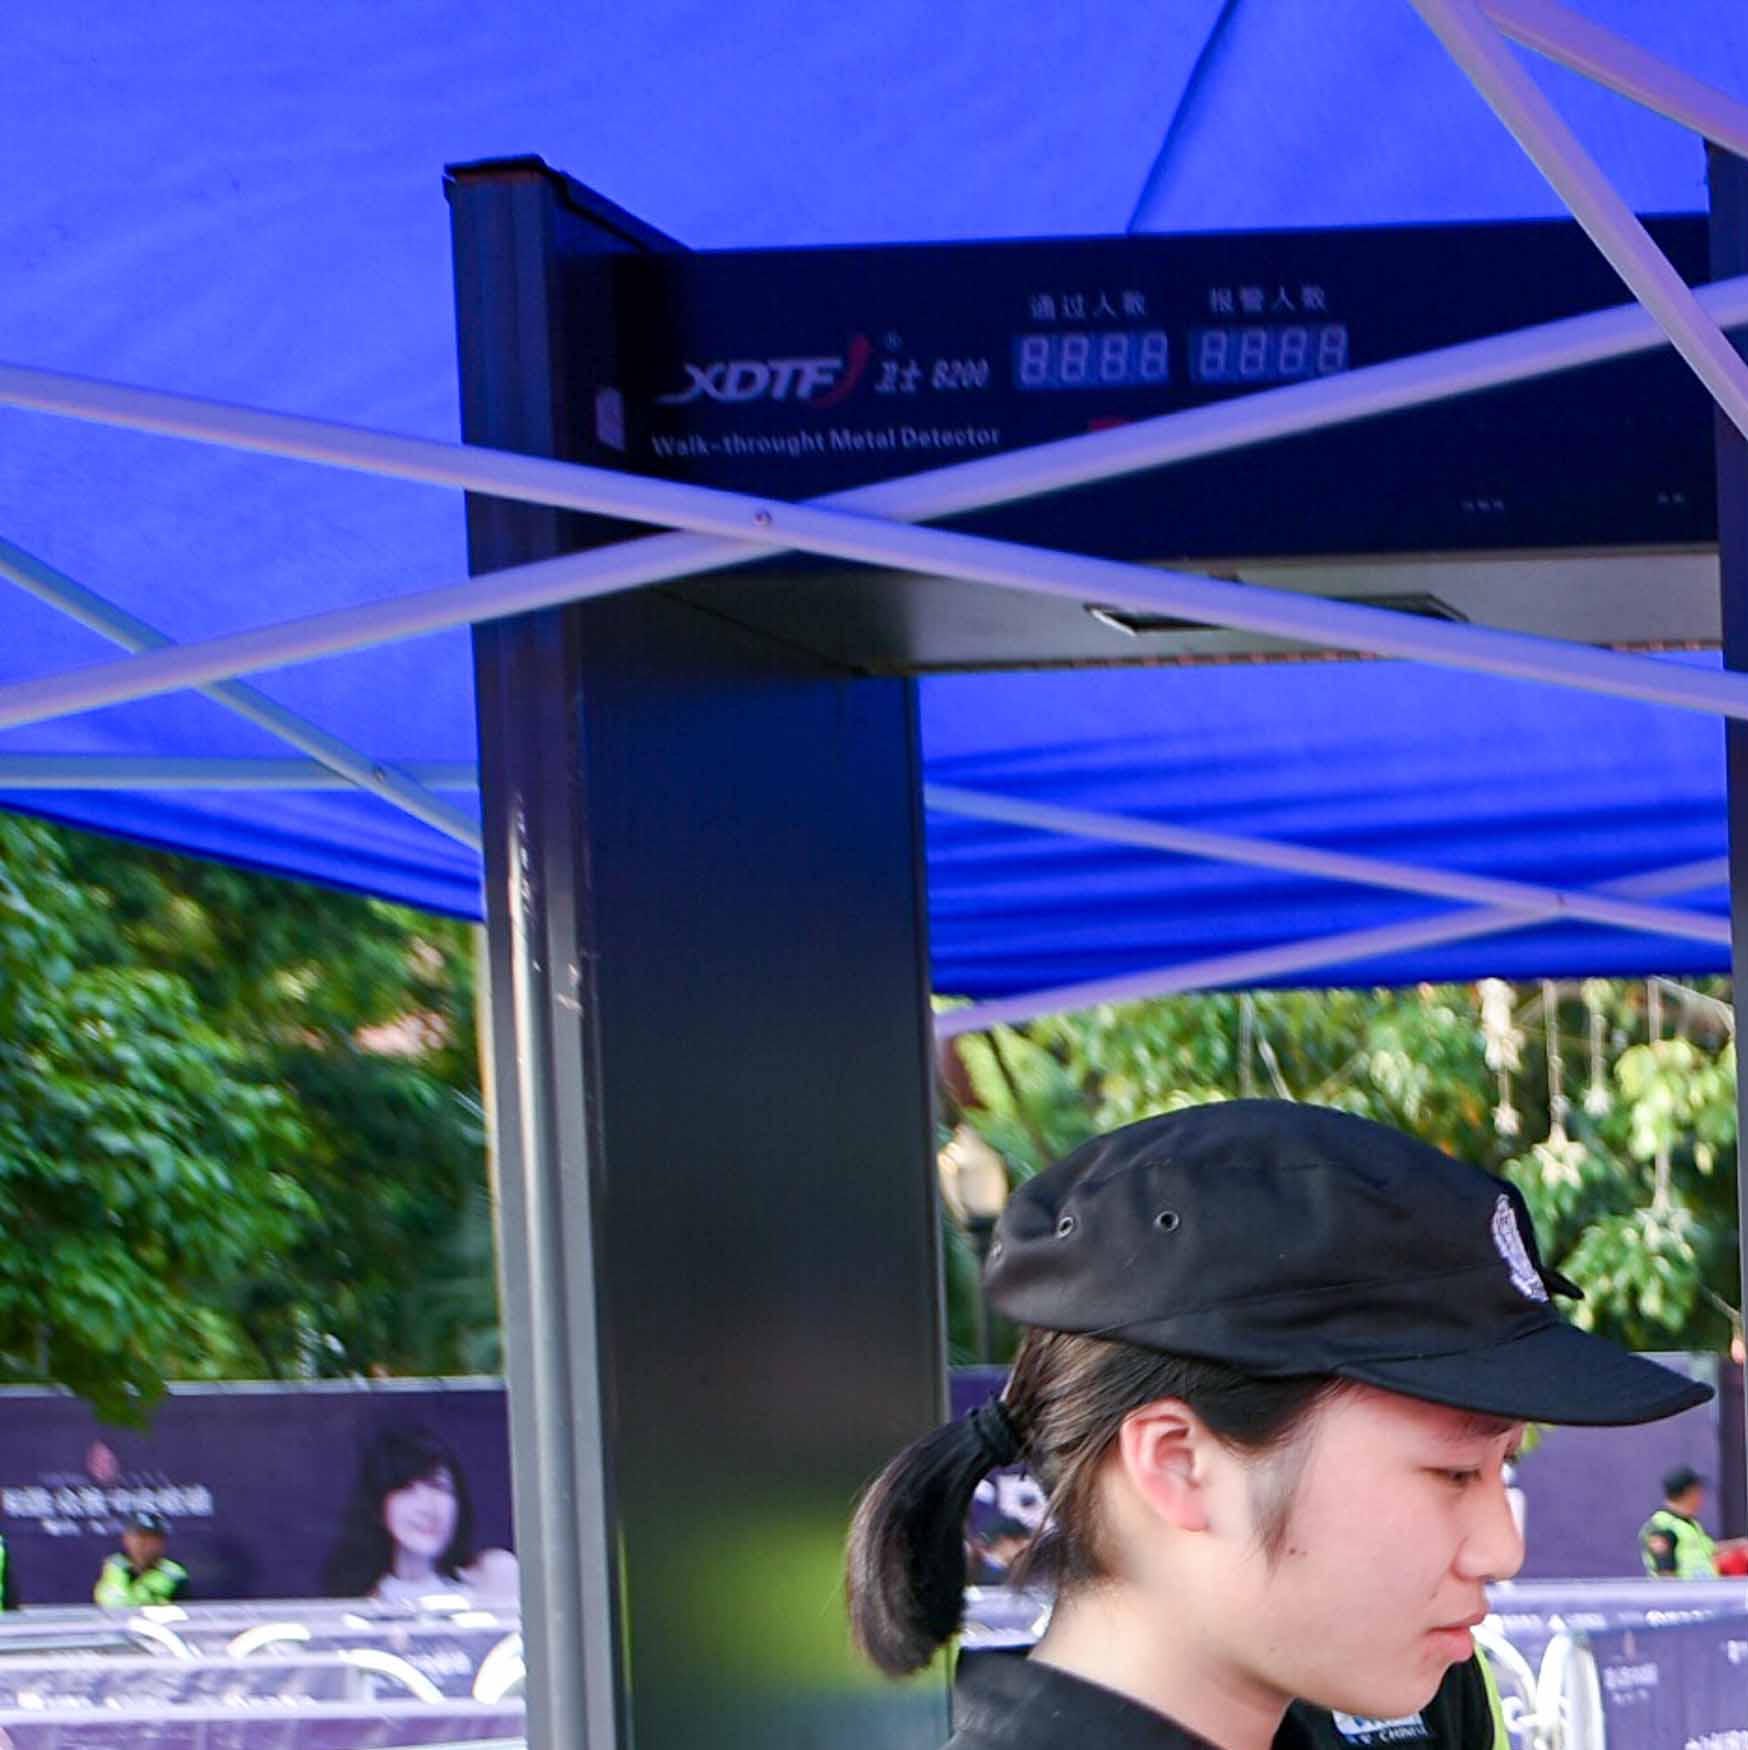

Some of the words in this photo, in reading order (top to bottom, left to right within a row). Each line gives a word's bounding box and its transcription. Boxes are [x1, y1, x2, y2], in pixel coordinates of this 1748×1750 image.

[659, 356, 843, 404] XDTF
[829, 426, 896, 450] Metal
[899, 422, 1000, 449] Detector
